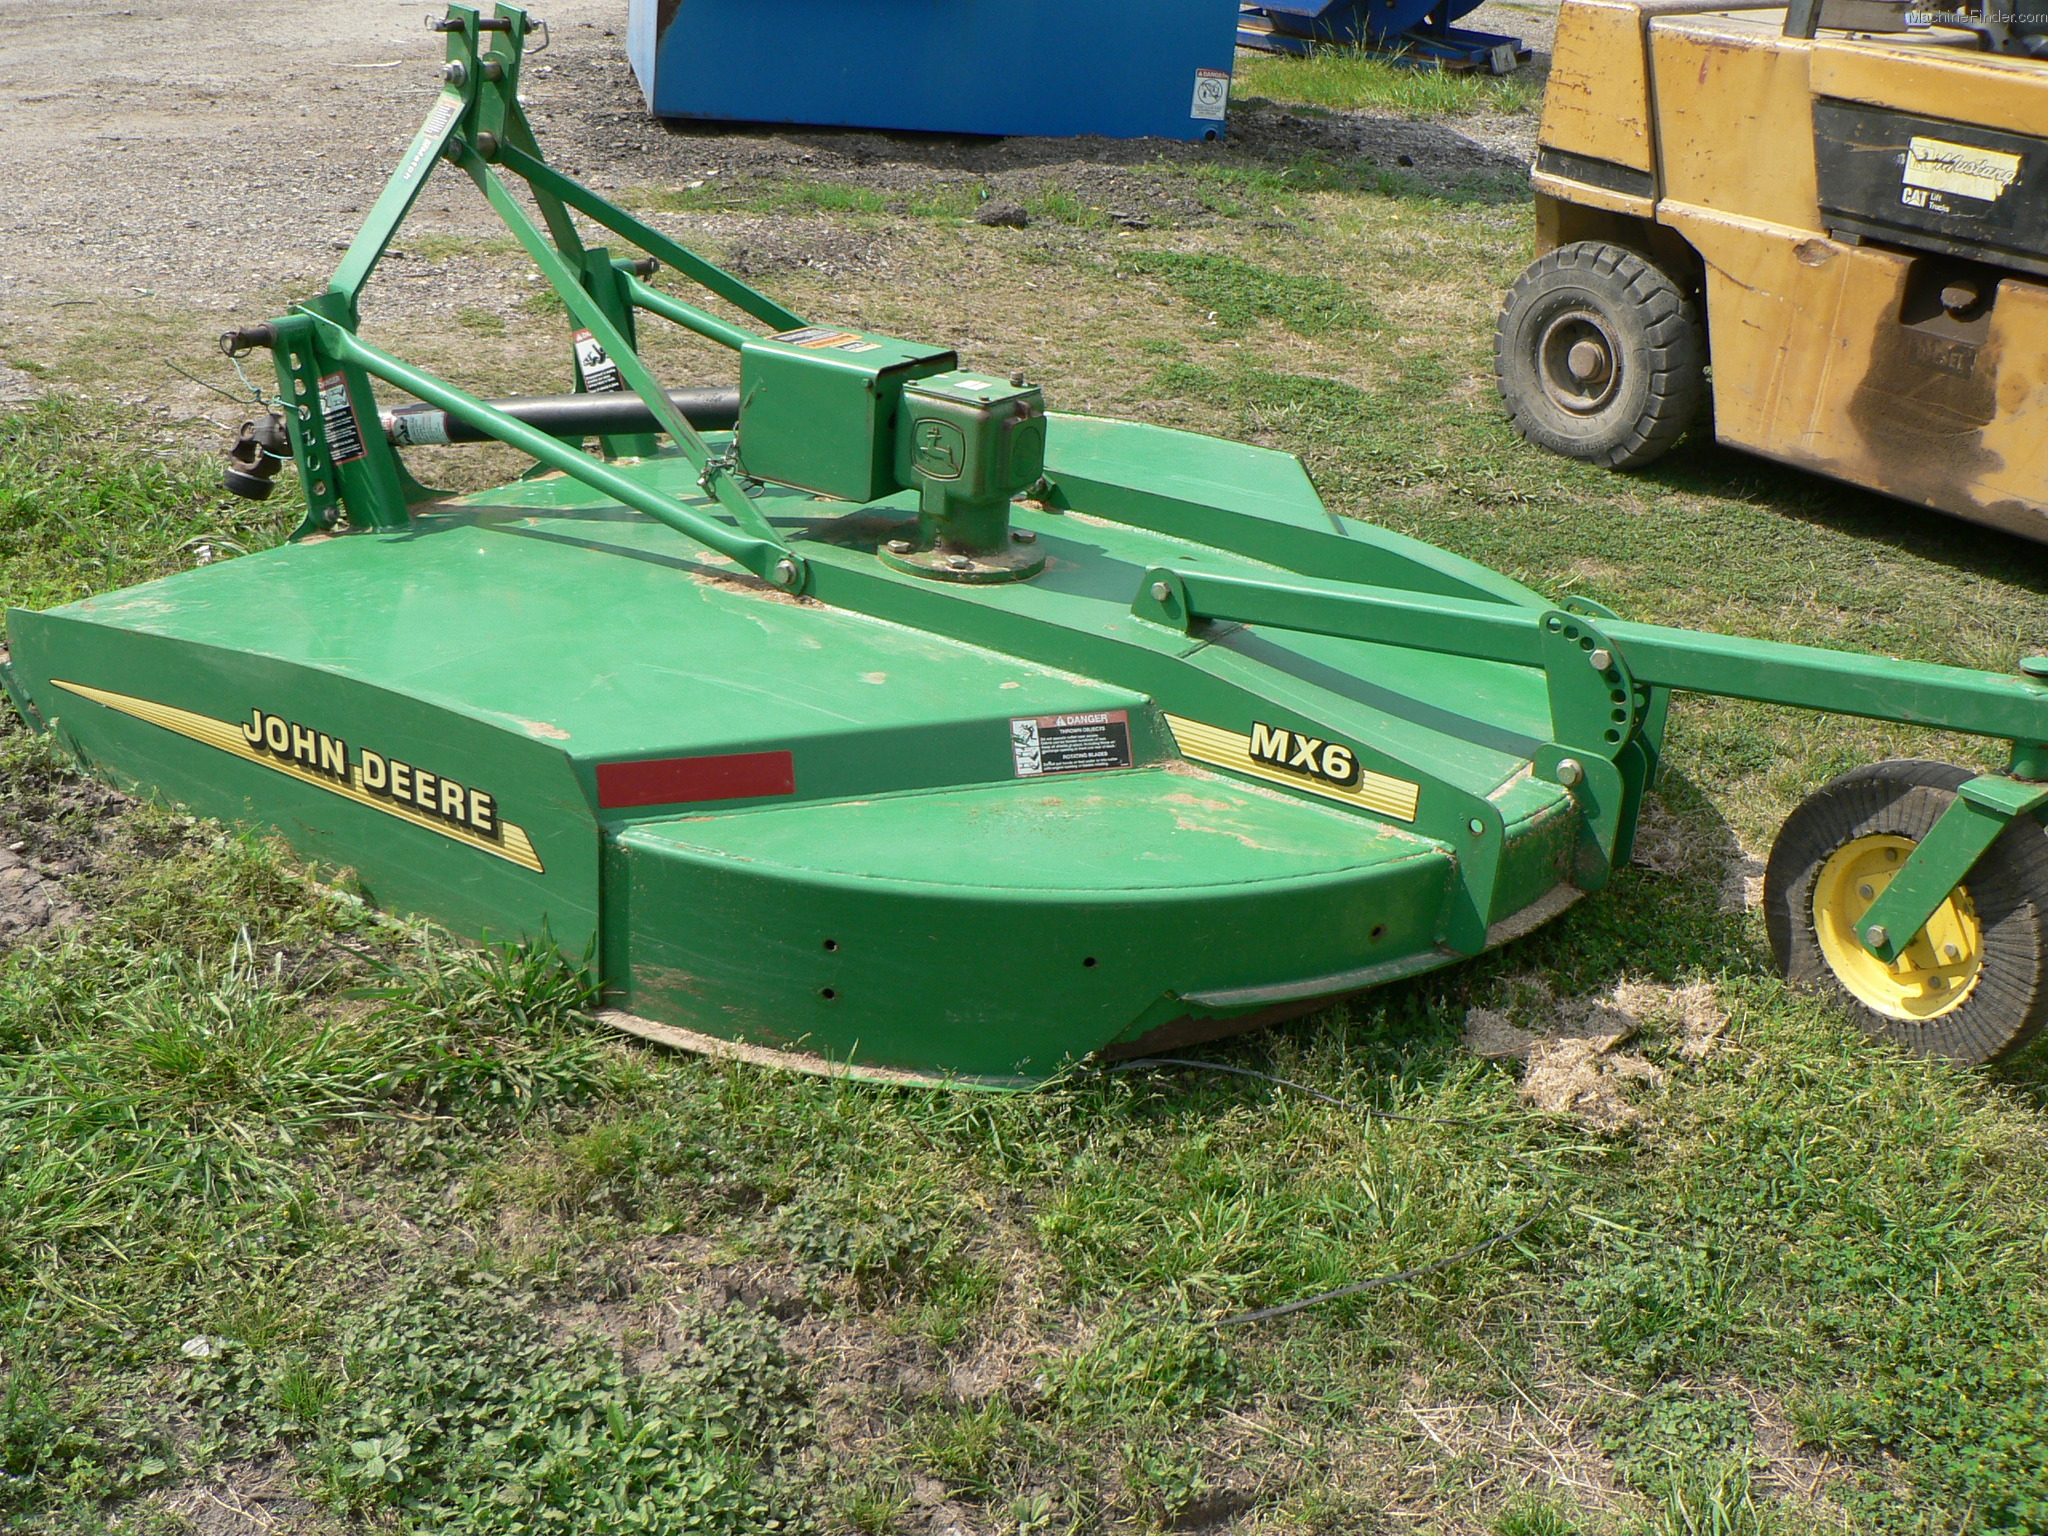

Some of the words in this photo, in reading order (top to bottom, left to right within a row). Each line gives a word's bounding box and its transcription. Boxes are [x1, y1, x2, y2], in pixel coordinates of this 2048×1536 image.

[1902, 187, 1928, 208] CAT
[1930, 193, 1942, 202] Lift
[1929, 202, 1950, 213] Trucks
[1066, 713, 1109, 725] DANGER
[1249, 720, 1360, 788] MX6
[241, 707, 351, 780] JOHN
[359, 746, 498, 841] DEERE
